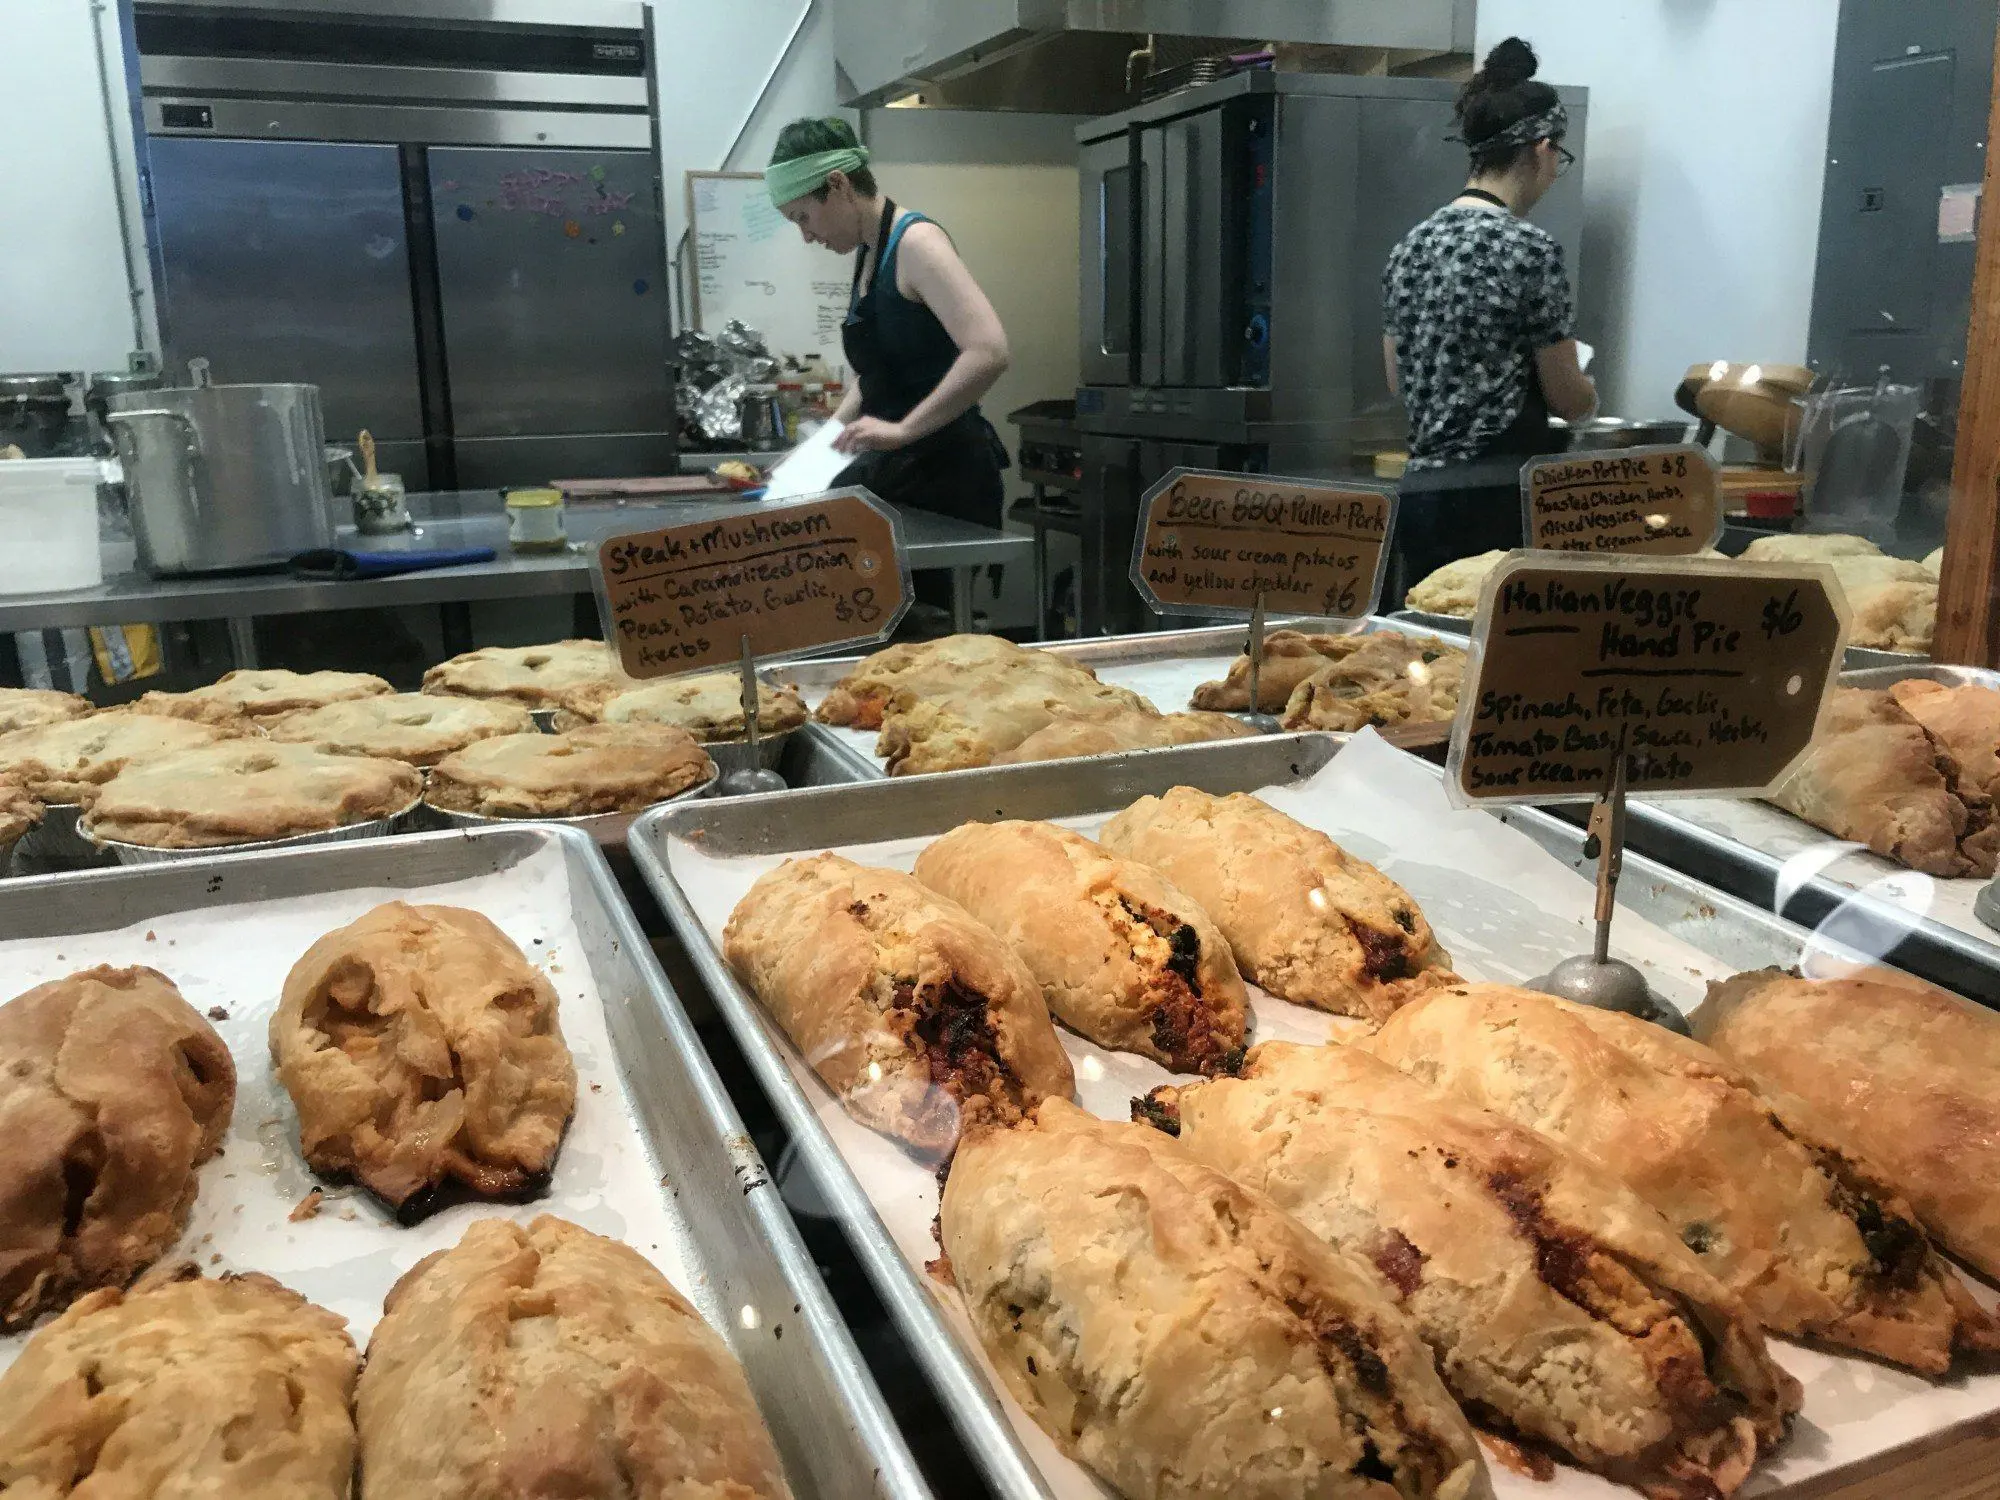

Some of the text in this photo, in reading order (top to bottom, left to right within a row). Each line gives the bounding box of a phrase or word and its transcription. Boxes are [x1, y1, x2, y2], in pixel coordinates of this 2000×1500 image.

[1533, 466, 1591, 486] Chicken
[1593, 460, 1620, 480] Pot
[1620, 457, 1650, 479] Pie
[1347, 501, 1386, 532] Pork
[1535, 492, 1589, 515] Roasted
[1540, 513, 1585, 538] Mixed
[610, 535, 688, 575] Steak
[702, 513, 832, 555] Mushroom
[1542, 538, 1593, 551] tter
[1596, 534, 1643, 551] Cream
[615, 586, 662, 614] with
[664, 555, 794, 600] Caramelized
[1183, 568, 1236, 597] yellow
[835, 587, 882, 624] $8
[1502, 577, 1701, 628] Italian Veggie
[1760, 587, 1804, 640] $6
[638, 637, 711, 668] Herbs
[1599, 620, 1741, 662] Hand Pie
[1470, 728, 1560, 758] Tomato
[1470, 764, 1524, 789] Sour
[1527, 760, 1604, 783] Cream
